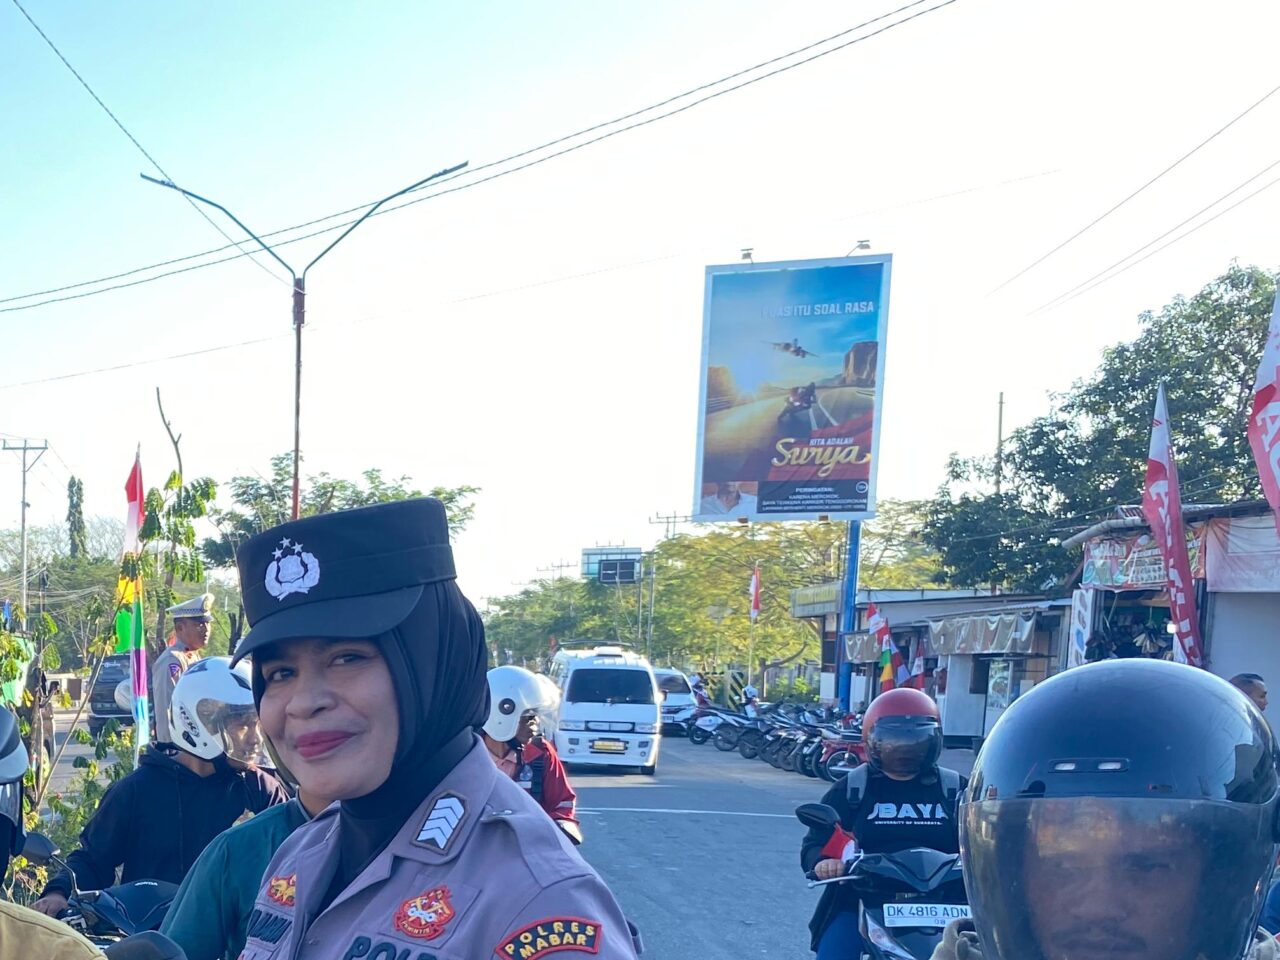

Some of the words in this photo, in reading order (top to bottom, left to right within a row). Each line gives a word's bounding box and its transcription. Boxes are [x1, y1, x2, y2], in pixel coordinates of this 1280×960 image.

[793, 304, 811, 316] ITU
[814, 303, 842, 315] SOAL
[845, 301, 874, 313] RASA
[771, 437, 871, 477] Surya
[887, 906, 906, 917] DK
[908, 906, 938, 917] 4816
[942, 907, 968, 917] ADN
[505, 922, 595, 954] POLRES
[520, 933, 587, 959] MABAR
